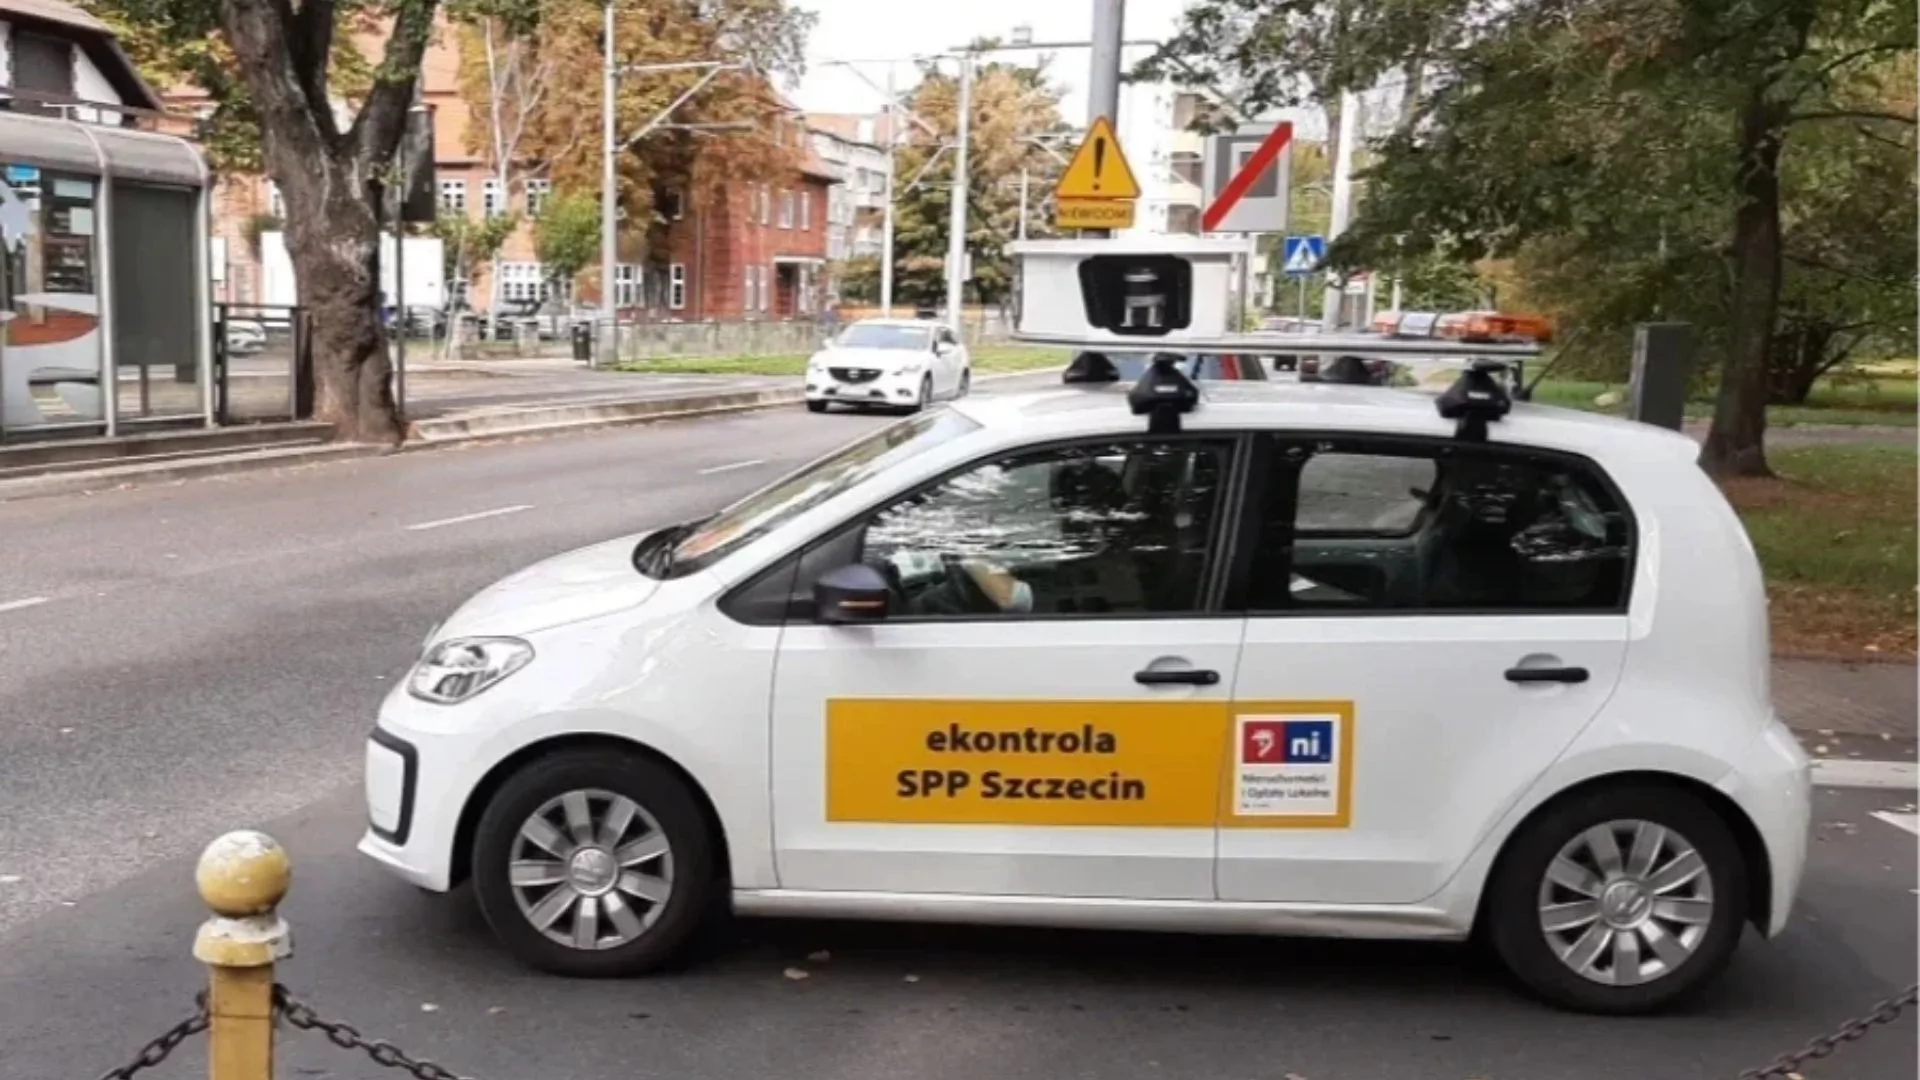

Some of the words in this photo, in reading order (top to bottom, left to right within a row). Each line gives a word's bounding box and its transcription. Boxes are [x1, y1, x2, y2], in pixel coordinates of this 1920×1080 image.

[926, 722, 1116, 754] ekontrola
[1291, 731, 1320, 756] ni
[896, 769, 970, 797] SPP
[980, 770, 1146, 800] Szczecin
